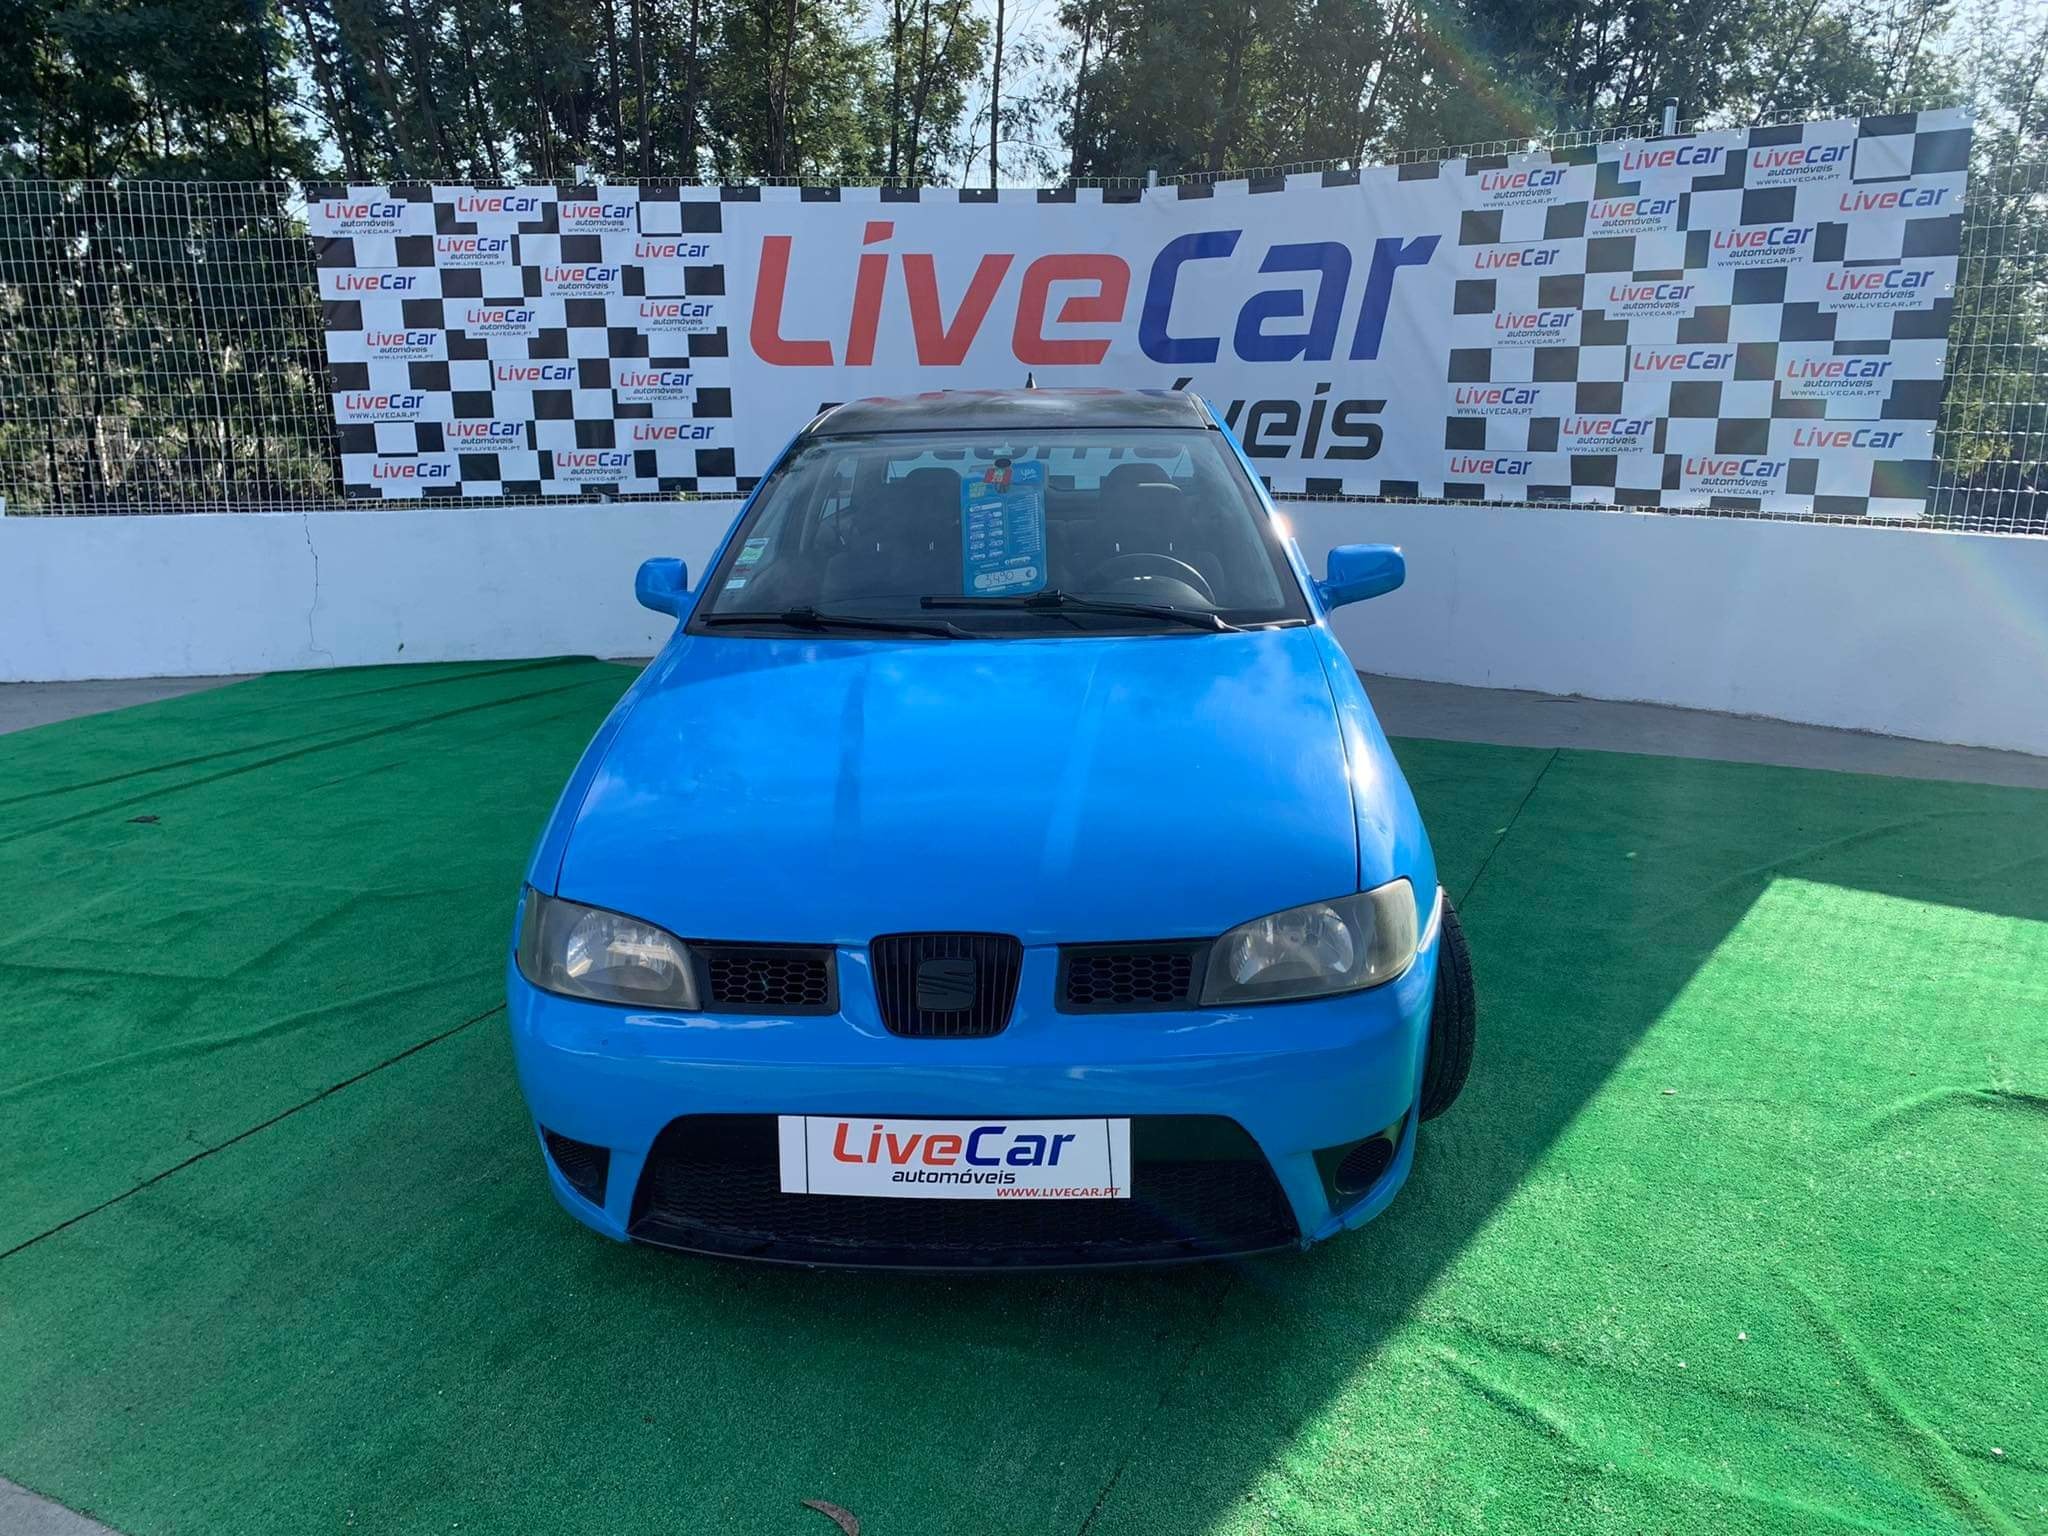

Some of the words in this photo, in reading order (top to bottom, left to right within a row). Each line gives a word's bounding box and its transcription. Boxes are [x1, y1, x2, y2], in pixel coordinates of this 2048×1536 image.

[1623, 146, 1724, 171] LiveCar
[1753, 144, 1850, 169] LiveCar
[1481, 169, 1567, 191] LiveCar
[458, 196, 538, 212] LiveCar
[1590, 198, 1677, 219] LiveCar
[1840, 188, 1948, 212] LiveCar
[325, 202, 405, 218] LiveCar
[562, 204, 634, 218] LiveCar
[437, 238, 509, 252] LiveCar
[1714, 226, 1814, 249] LiveCar
[634, 243, 710, 258] LiveCar
[1474, 249, 1560, 269] LiveCar
[336, 274, 416, 290] LiveCar
[544, 266, 619, 282] LiveCar
[1826, 270, 1935, 291] LiveCar
[749, 221, 1442, 366] LiveCar
[1609, 284, 1695, 302] LiveCar
[467, 309, 536, 323] LiveCar
[640, 302, 714, 317] LiveCar
[1495, 312, 1574, 329] LiveCar
[366, 332, 437, 346] LiveCar
[1634, 352, 1733, 370] LiveCar
[1787, 359, 1893, 378] LiveCar
[497, 365, 576, 380] LiveCar
[620, 372, 693, 387] LiveCar
[346, 394, 424, 409] LiveCar
[1456, 386, 1540, 405] LiveCar
[447, 421, 524, 436] LiveCar
[633, 424, 714, 440] LiveCar
[1563, 416, 1653, 436] LiveCar
[1793, 427, 1903, 449] LiveCar
[557, 452, 632, 467] LiveCar
[1450, 456, 1532, 475] LiveCar
[1685, 457, 1786, 478] LiveCar
[373, 463, 451, 479] LiveCar
[832, 1122, 1075, 1167] LiveCar
[892, 1168, 1016, 1185] automóveis
[996, 1187, 1121, 1198] WWW.LIVECAR.PT
